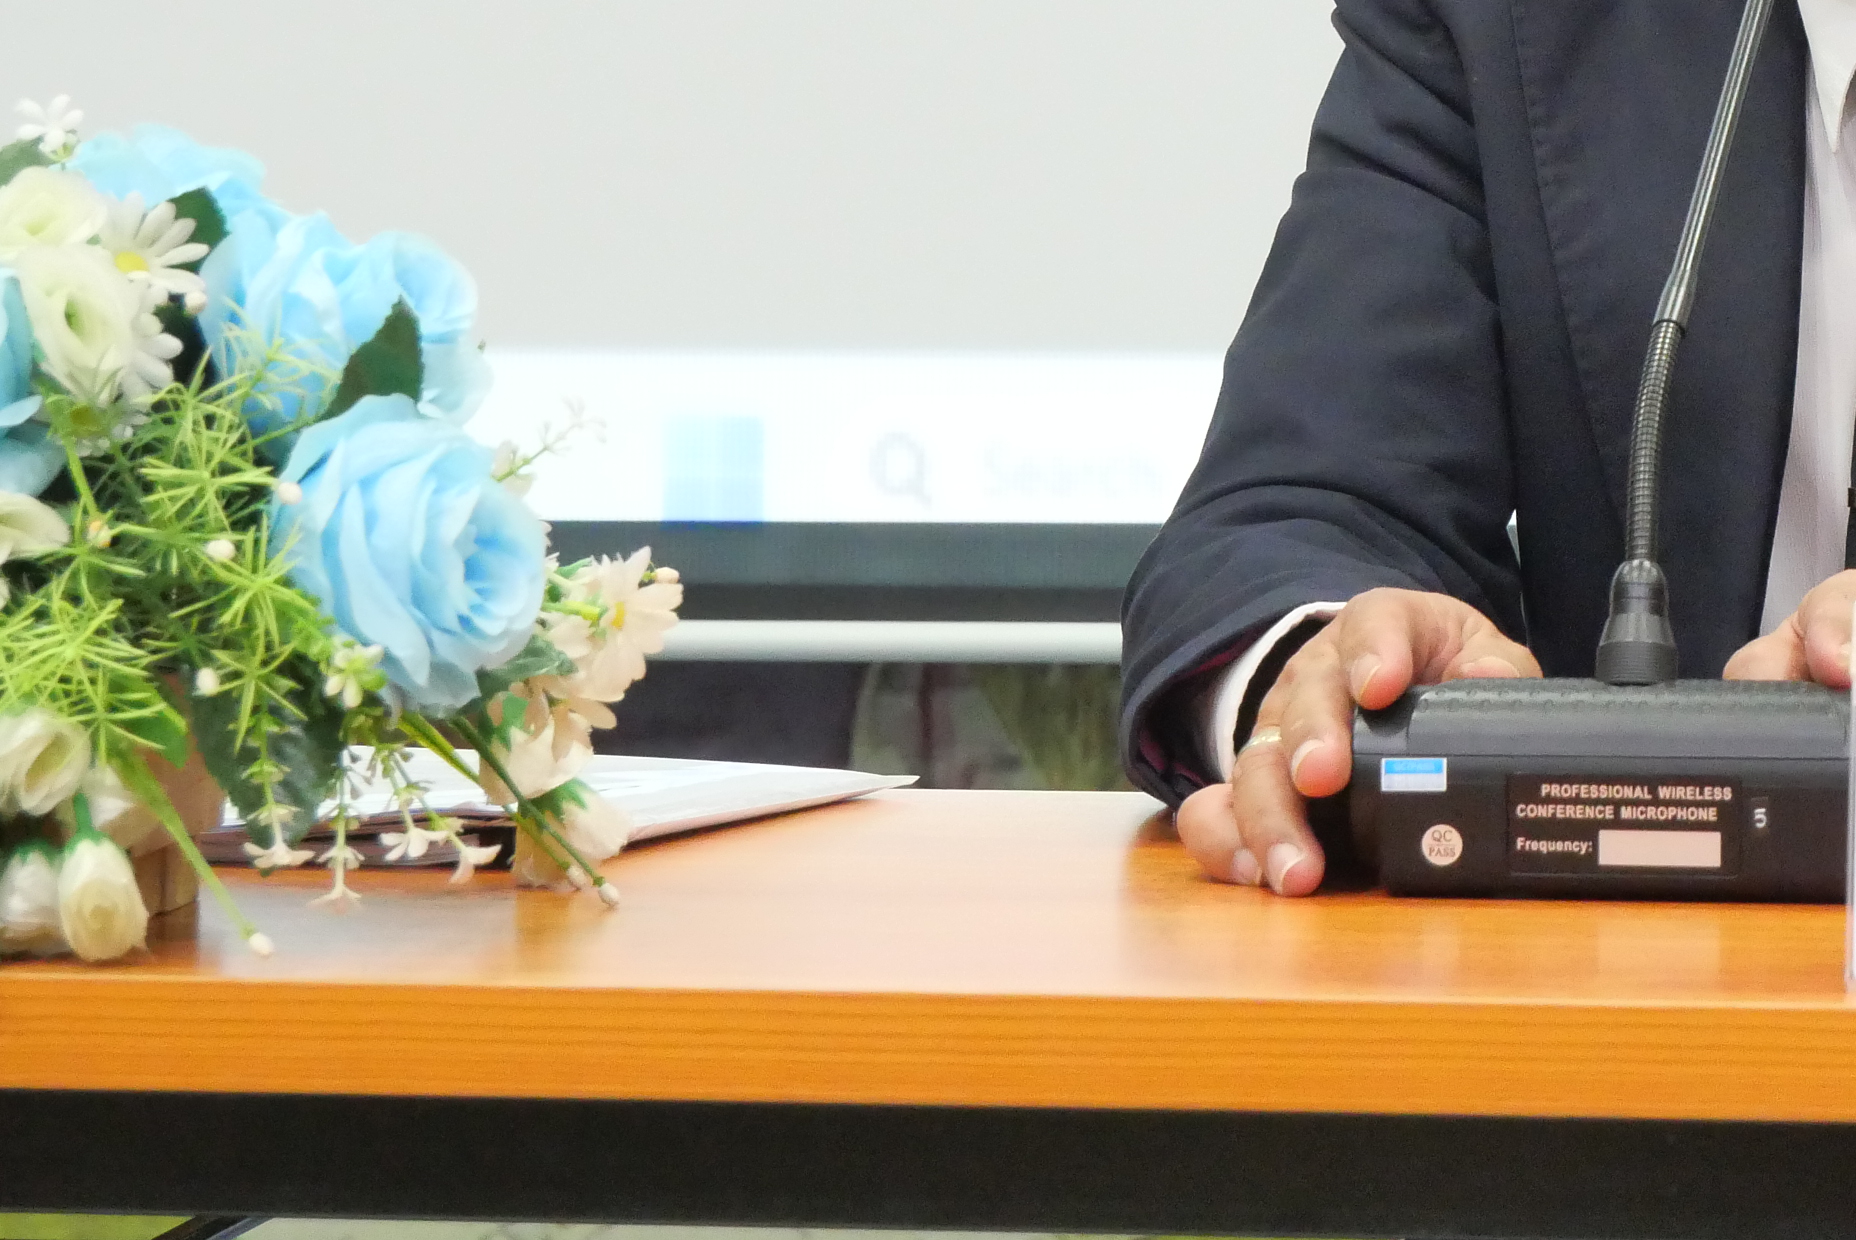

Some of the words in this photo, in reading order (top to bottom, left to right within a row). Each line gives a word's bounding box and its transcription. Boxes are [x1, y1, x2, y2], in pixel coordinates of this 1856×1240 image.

[1540, 783, 1652, 800] PROFESSIONAL
[1657, 785, 1733, 802] WIRELESS
[1515, 804, 1615, 820] CONFERENCE
[1620, 805, 1718, 822] MICROPHONE
[1753, 807, 1768, 830] 5
[1431, 829, 1453, 842] QC
[1427, 846, 1456, 858] PASS
[1515, 836, 1593, 855] Frequency:
